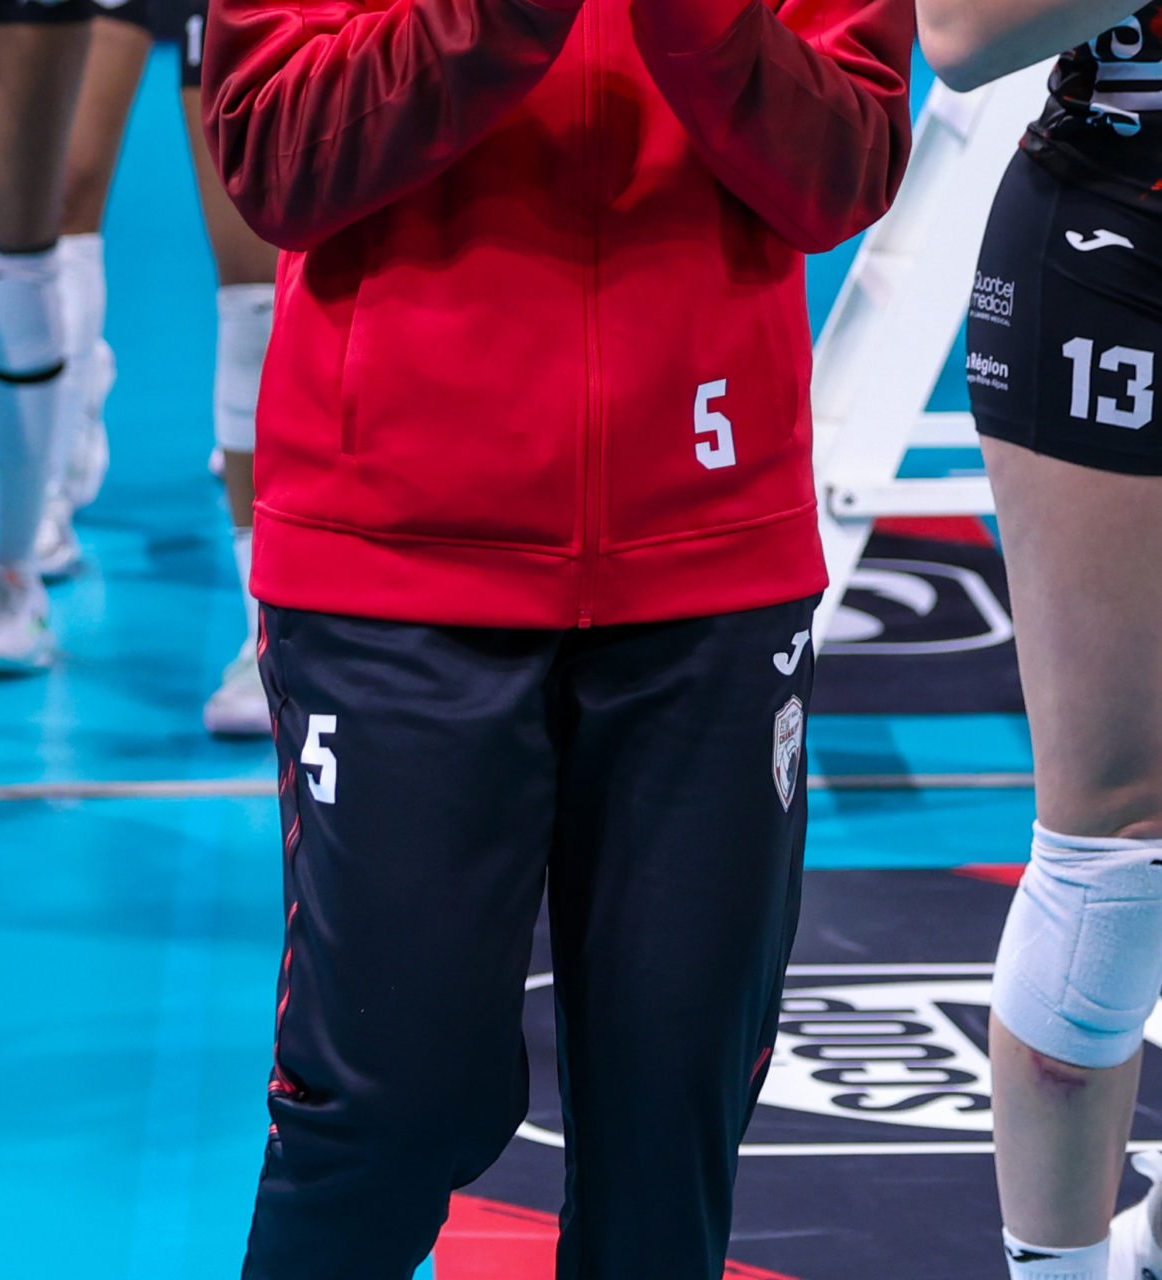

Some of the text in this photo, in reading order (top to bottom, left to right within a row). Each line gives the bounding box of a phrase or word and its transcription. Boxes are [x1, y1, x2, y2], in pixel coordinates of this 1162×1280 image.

[693, 378, 737, 470] 5
[1062, 336, 1155, 430] 13
[300, 714, 337, 804] 5
[778, 996, 993, 1112] SCOOP
